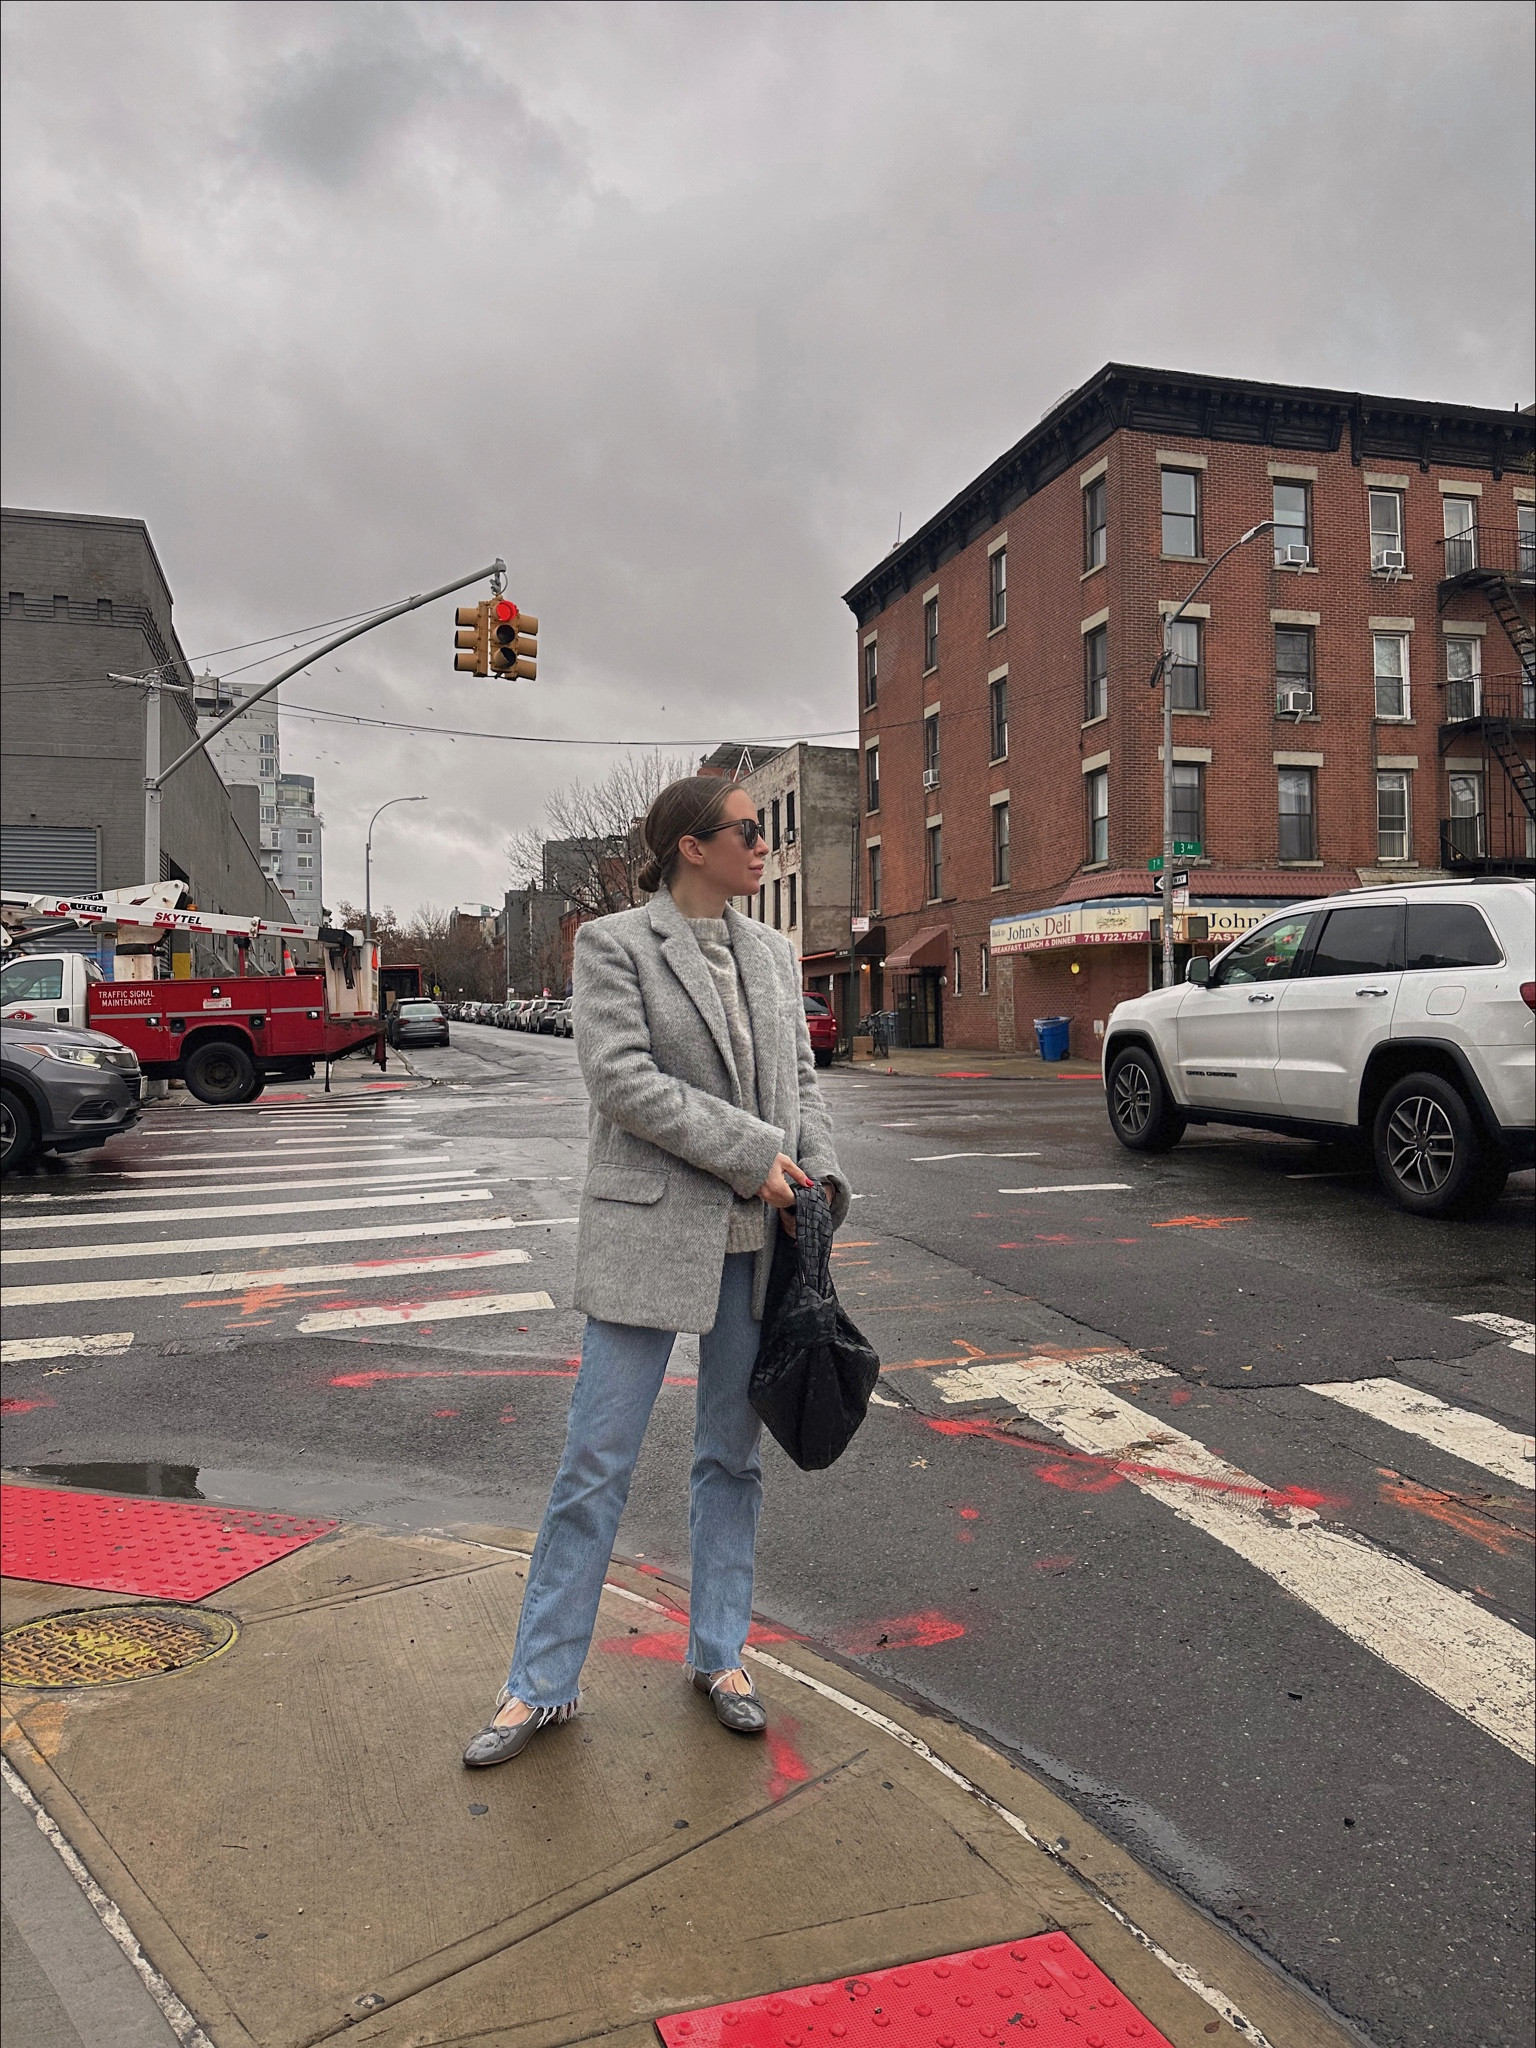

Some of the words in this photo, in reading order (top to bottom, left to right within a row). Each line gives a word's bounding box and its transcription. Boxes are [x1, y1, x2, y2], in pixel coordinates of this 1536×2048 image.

[1180, 843, 1185, 853] 3
[1173, 876, 1185, 885] WAY
[76, 904, 103, 912] UTEM
[155, 912, 202, 925] SKYTEL
[1208, 913, 1266, 929] John'
[1007, 922, 1040, 941] John's
[1045, 913, 1071, 937] Deli
[1084, 934, 1100, 942] 718
[1103, 932, 1144, 942] 722.7547
[1023, 941, 1044, 950] LUNCH
[1051, 936, 1077, 946] DINNER
[98, 990, 128, 999] TRAFFIC
[129, 990, 155, 998] SIGNAL
[101, 998, 152, 1007] MAINTENANCE
